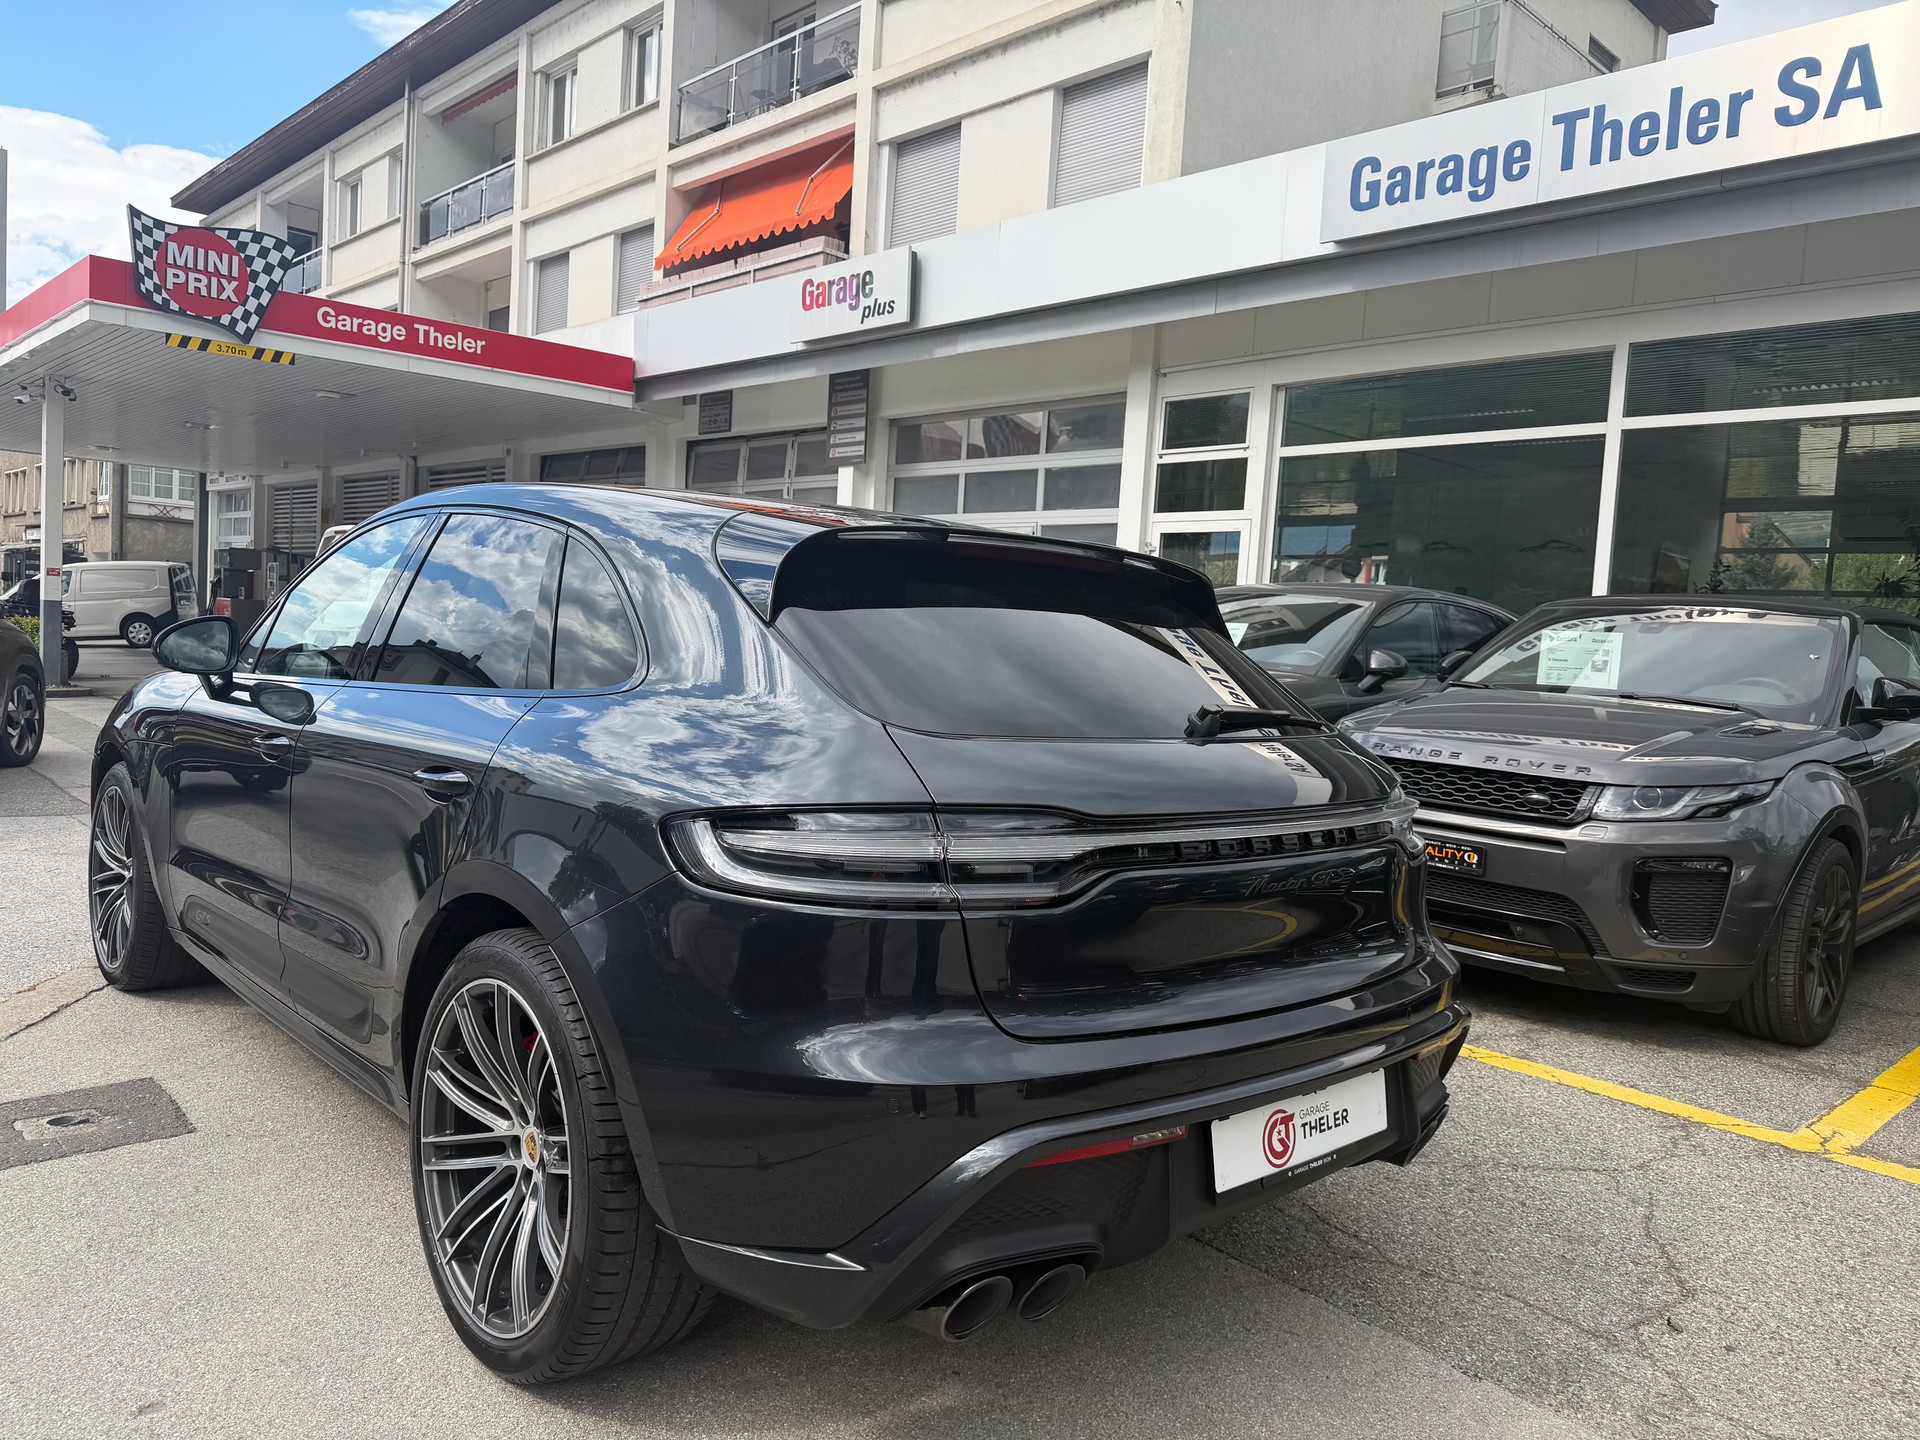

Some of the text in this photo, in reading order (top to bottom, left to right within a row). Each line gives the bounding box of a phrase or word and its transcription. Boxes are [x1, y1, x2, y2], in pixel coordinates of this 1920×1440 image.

[1349, 43, 1883, 212] Garage Theler SA
[166, 240, 239, 277] MINI
[165, 267, 239, 303] PRIX
[801, 270, 874, 312] Garage
[860, 298, 896, 324] plus
[316, 306, 486, 354] Garage Theler
[1372, 742, 1592, 776] RANGE ROVER
[1180, 826, 1369, 859] PORSCHE
[1425, 845, 1464, 860] ALITY
[1244, 874, 1308, 896] Macan
[195, 909, 211, 924] GTS
[1299, 1101, 1330, 1119] GARAGE
[1300, 1108, 1349, 1139] THELER
[1309, 1159, 1323, 1169] THELER
